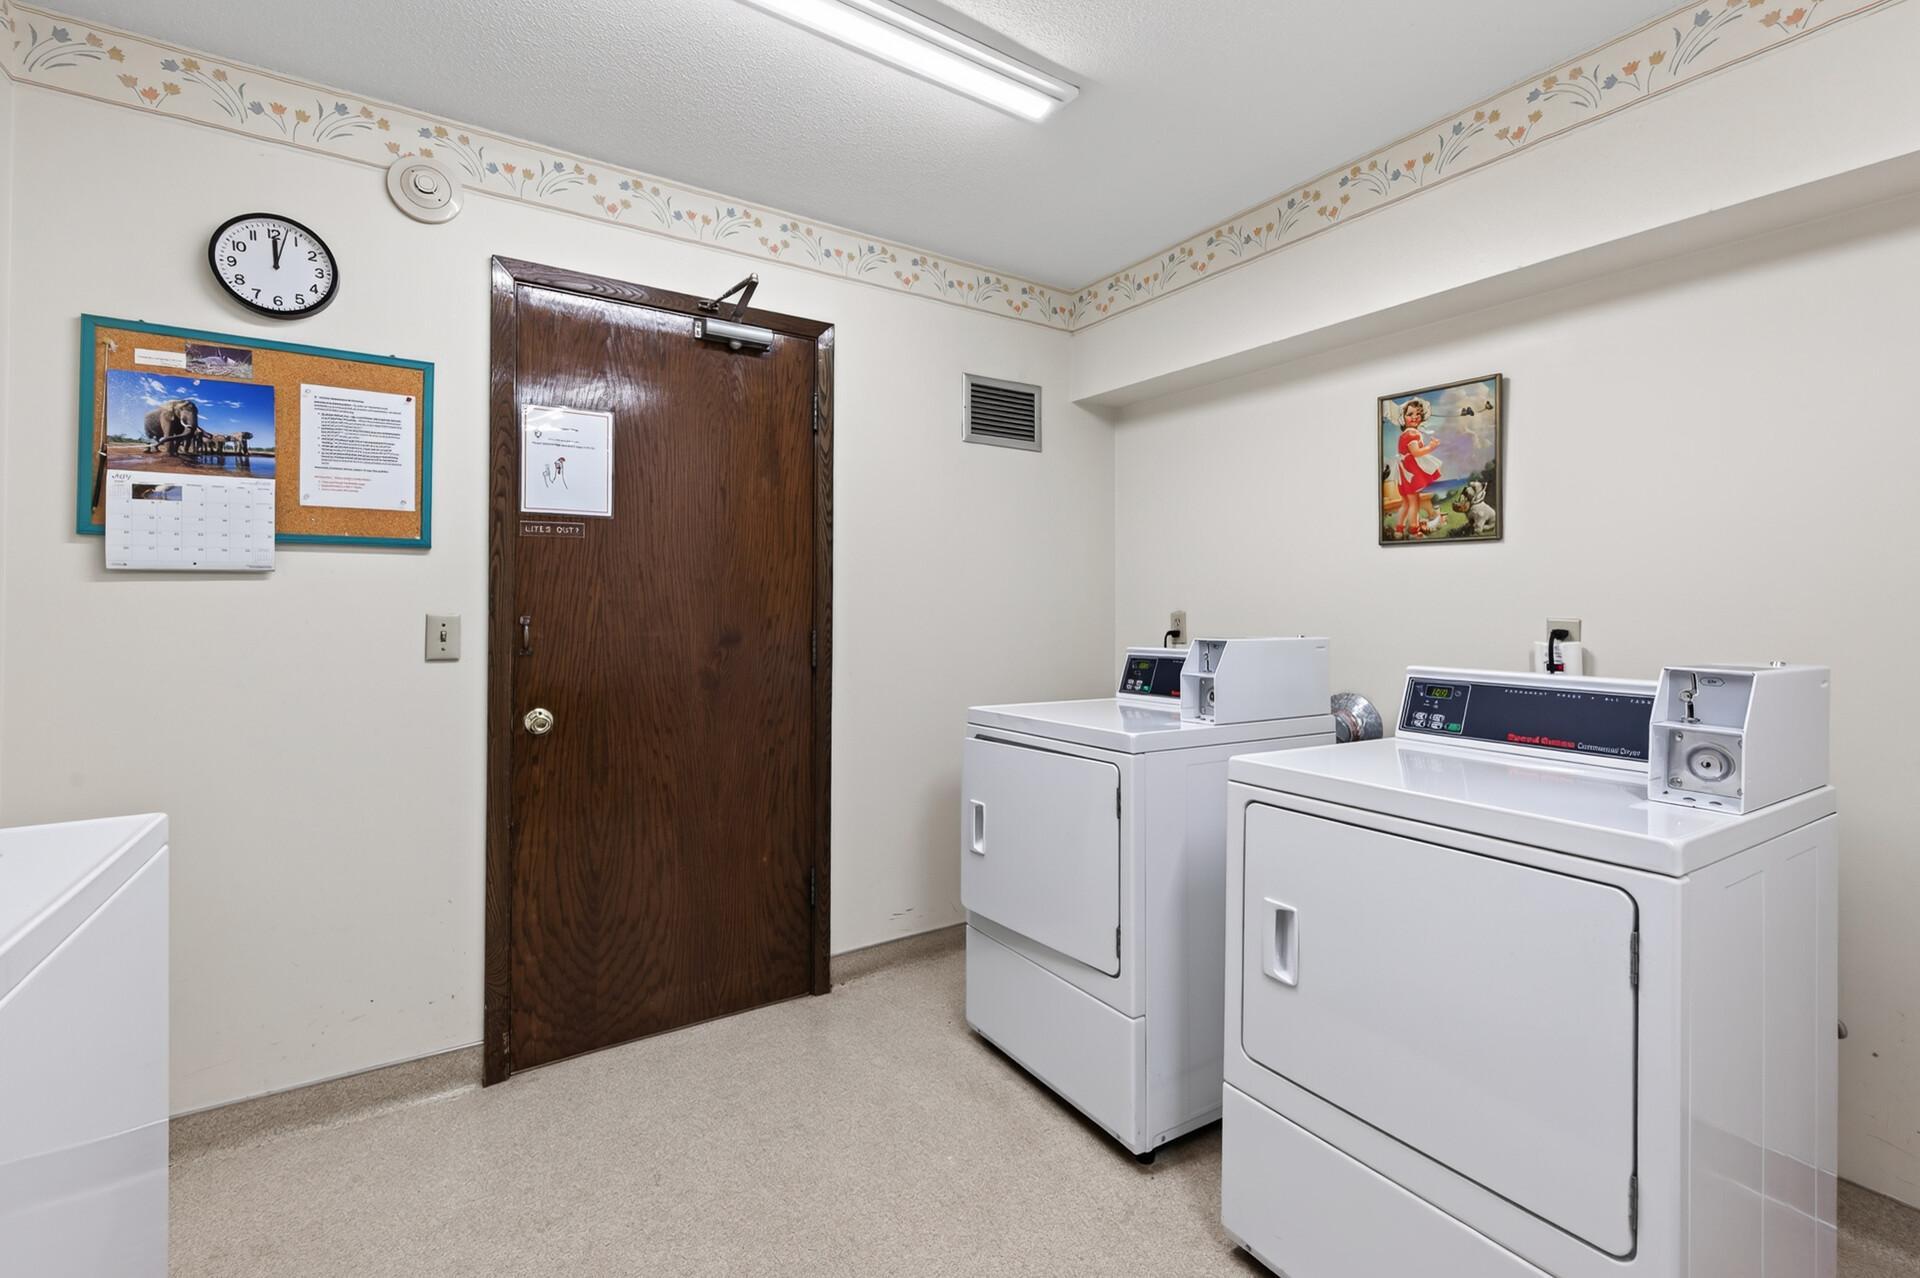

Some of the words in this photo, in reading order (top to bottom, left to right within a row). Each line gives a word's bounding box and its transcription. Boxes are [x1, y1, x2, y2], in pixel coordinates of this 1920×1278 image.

[249, 230, 257, 241] 11
[267, 228, 281, 241] 12
[232, 240, 247, 253] 10
[226, 255, 237, 267] 9
[307, 250, 318, 262] 2
[314, 267, 325, 279] 3
[234, 273, 246, 286] 8
[251, 288, 262, 300] 7
[309, 283, 319, 295] 4
[273, 295, 284, 307] 6
[295, 293, 305, 305] 5
